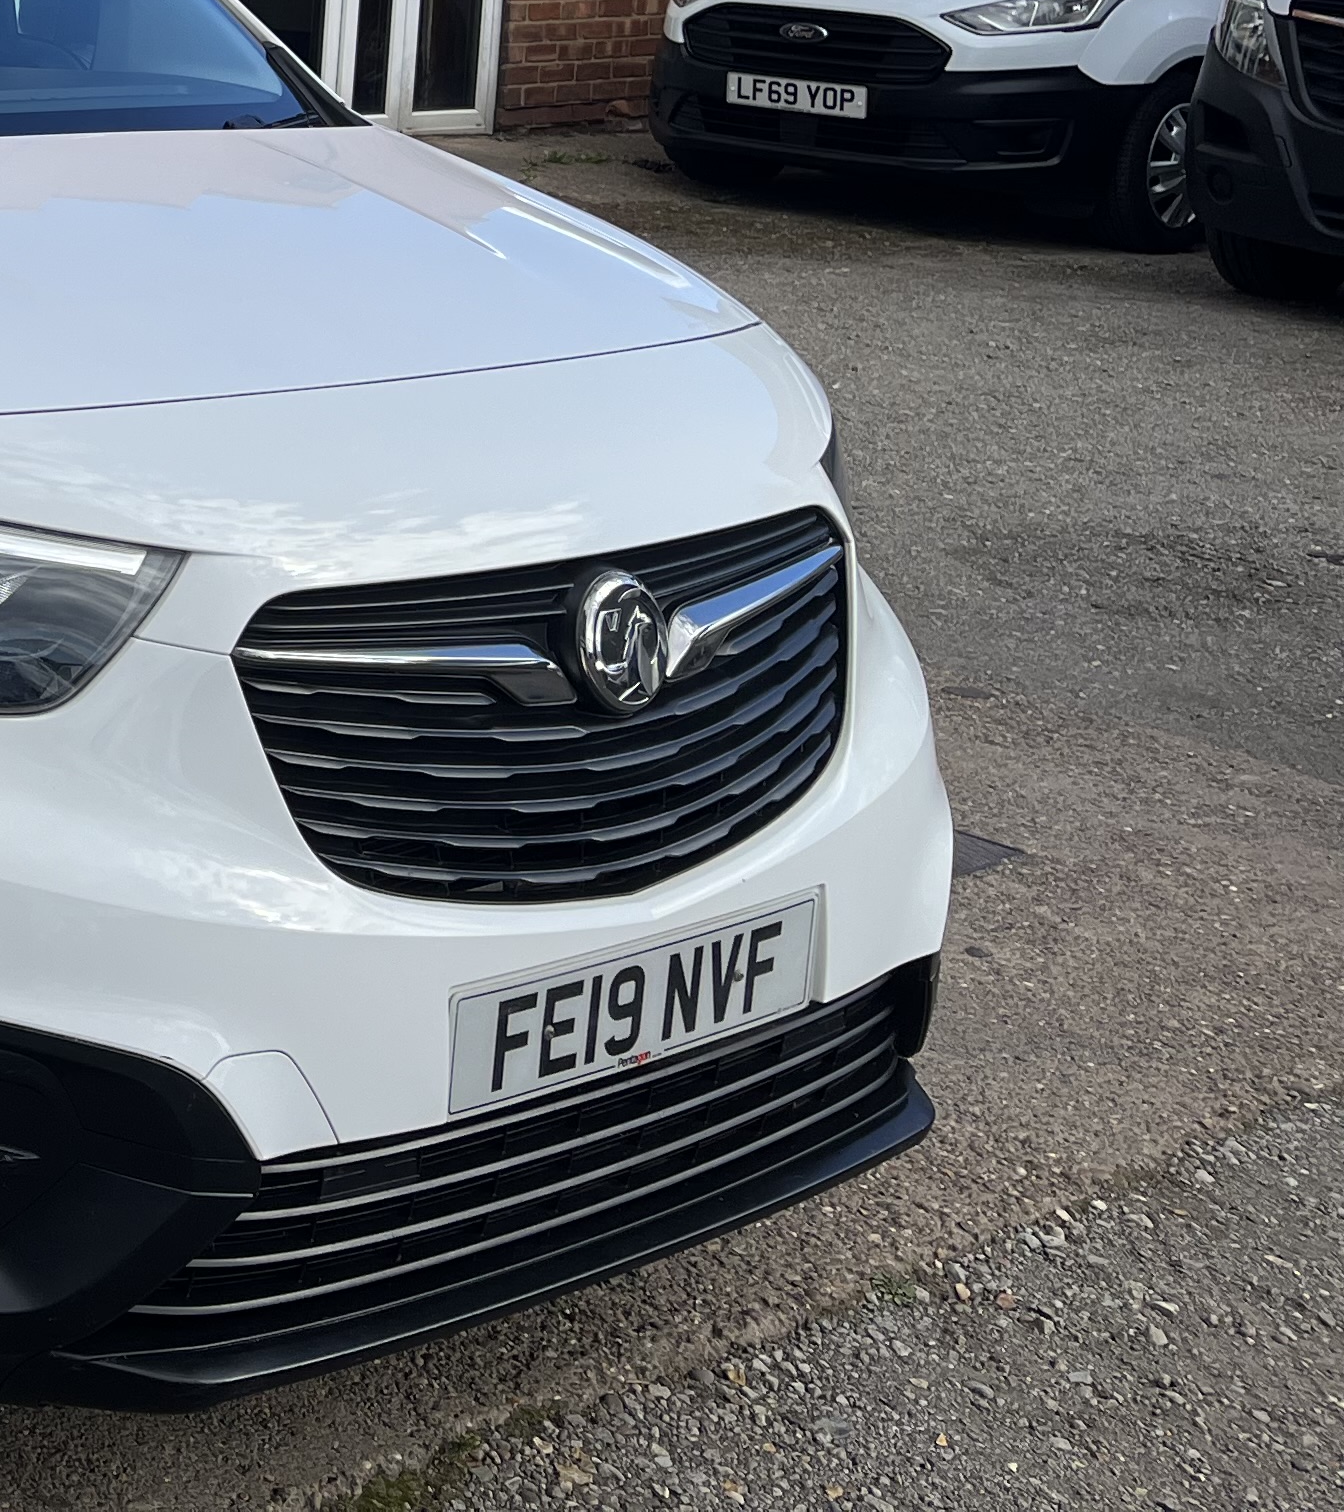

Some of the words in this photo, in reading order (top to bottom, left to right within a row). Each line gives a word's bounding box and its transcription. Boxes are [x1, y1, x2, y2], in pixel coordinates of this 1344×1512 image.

[736, 76, 798, 106] LF69
[806, 84, 855, 112] YOP
[490, 964, 647, 1093] FE19
[660, 920, 783, 1042] NVF
[617, 1050, 652, 1069] Pentagon
